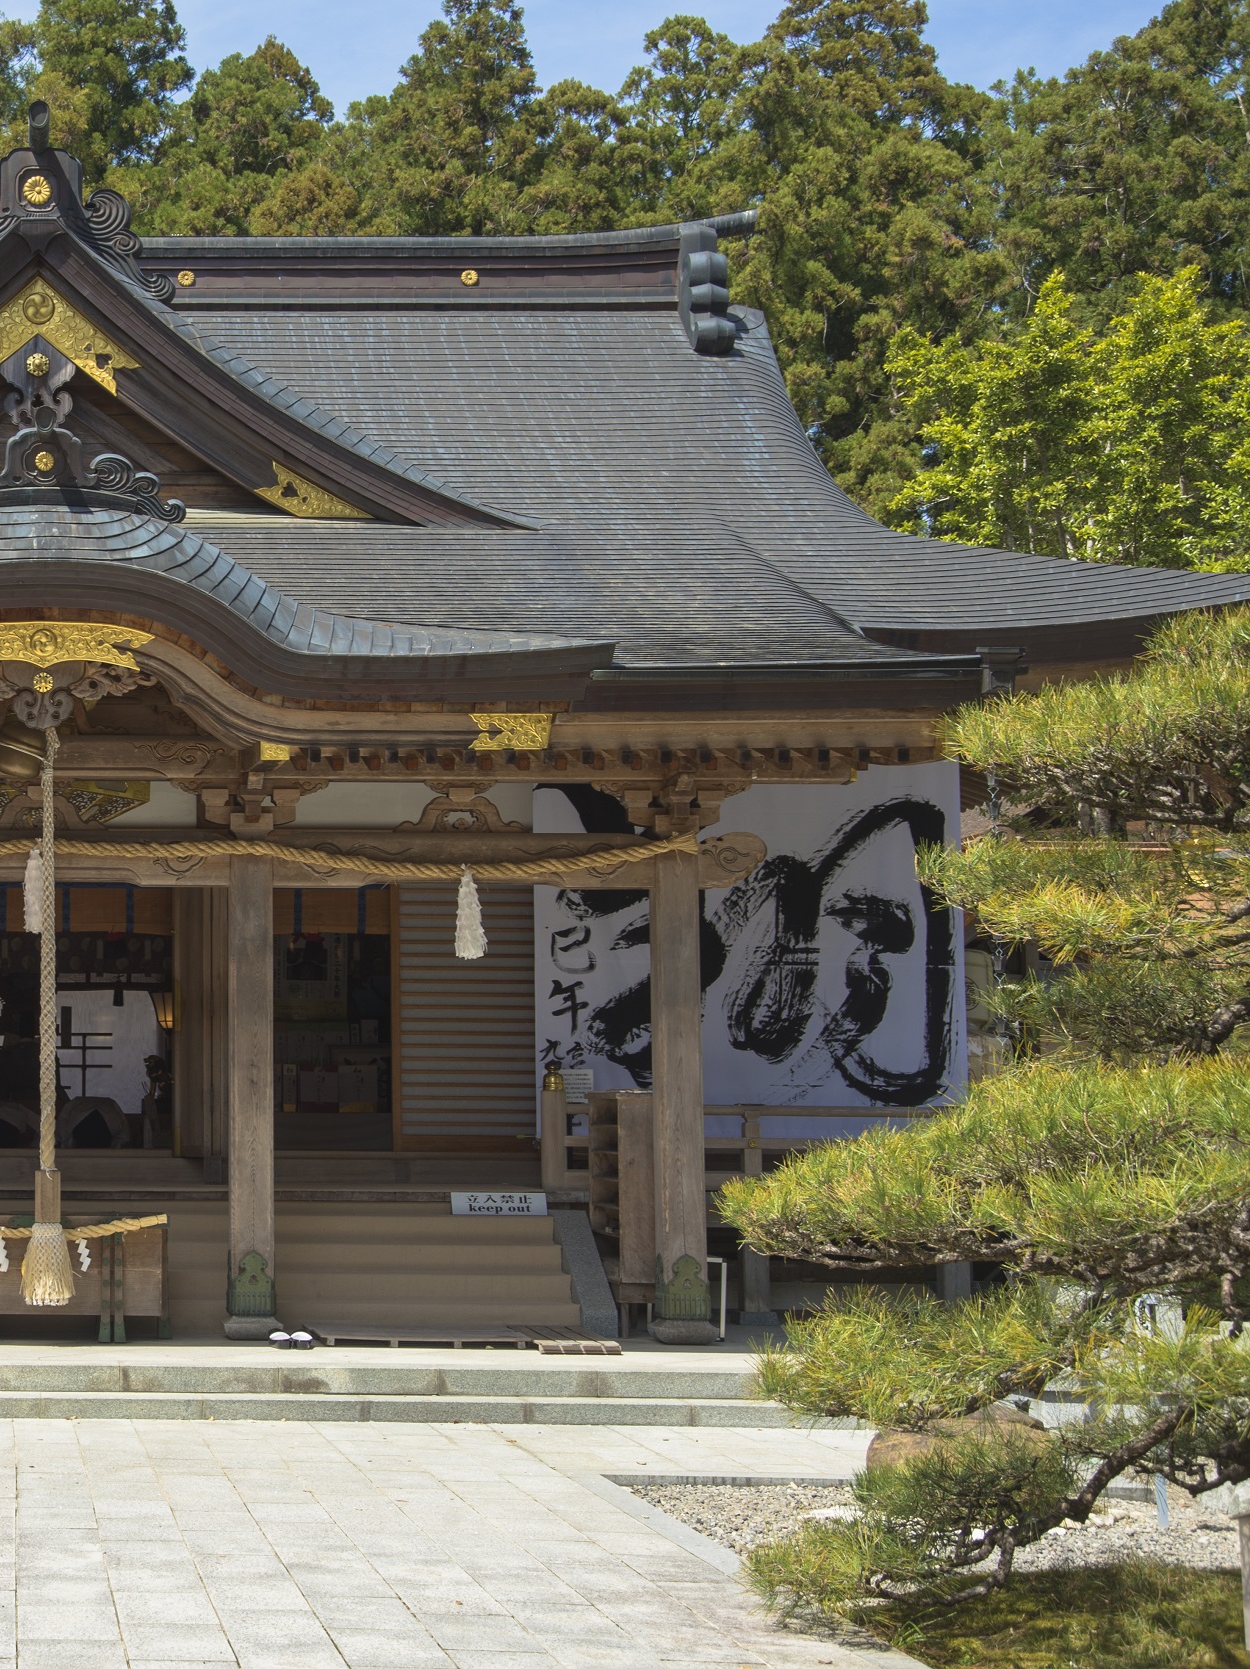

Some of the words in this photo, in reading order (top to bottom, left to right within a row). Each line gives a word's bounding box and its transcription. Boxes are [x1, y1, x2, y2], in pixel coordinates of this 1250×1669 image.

[466, 1194, 533, 1204] 立入禁止
[468, 1203, 503, 1214] keep
[509, 1204, 531, 1212] out
